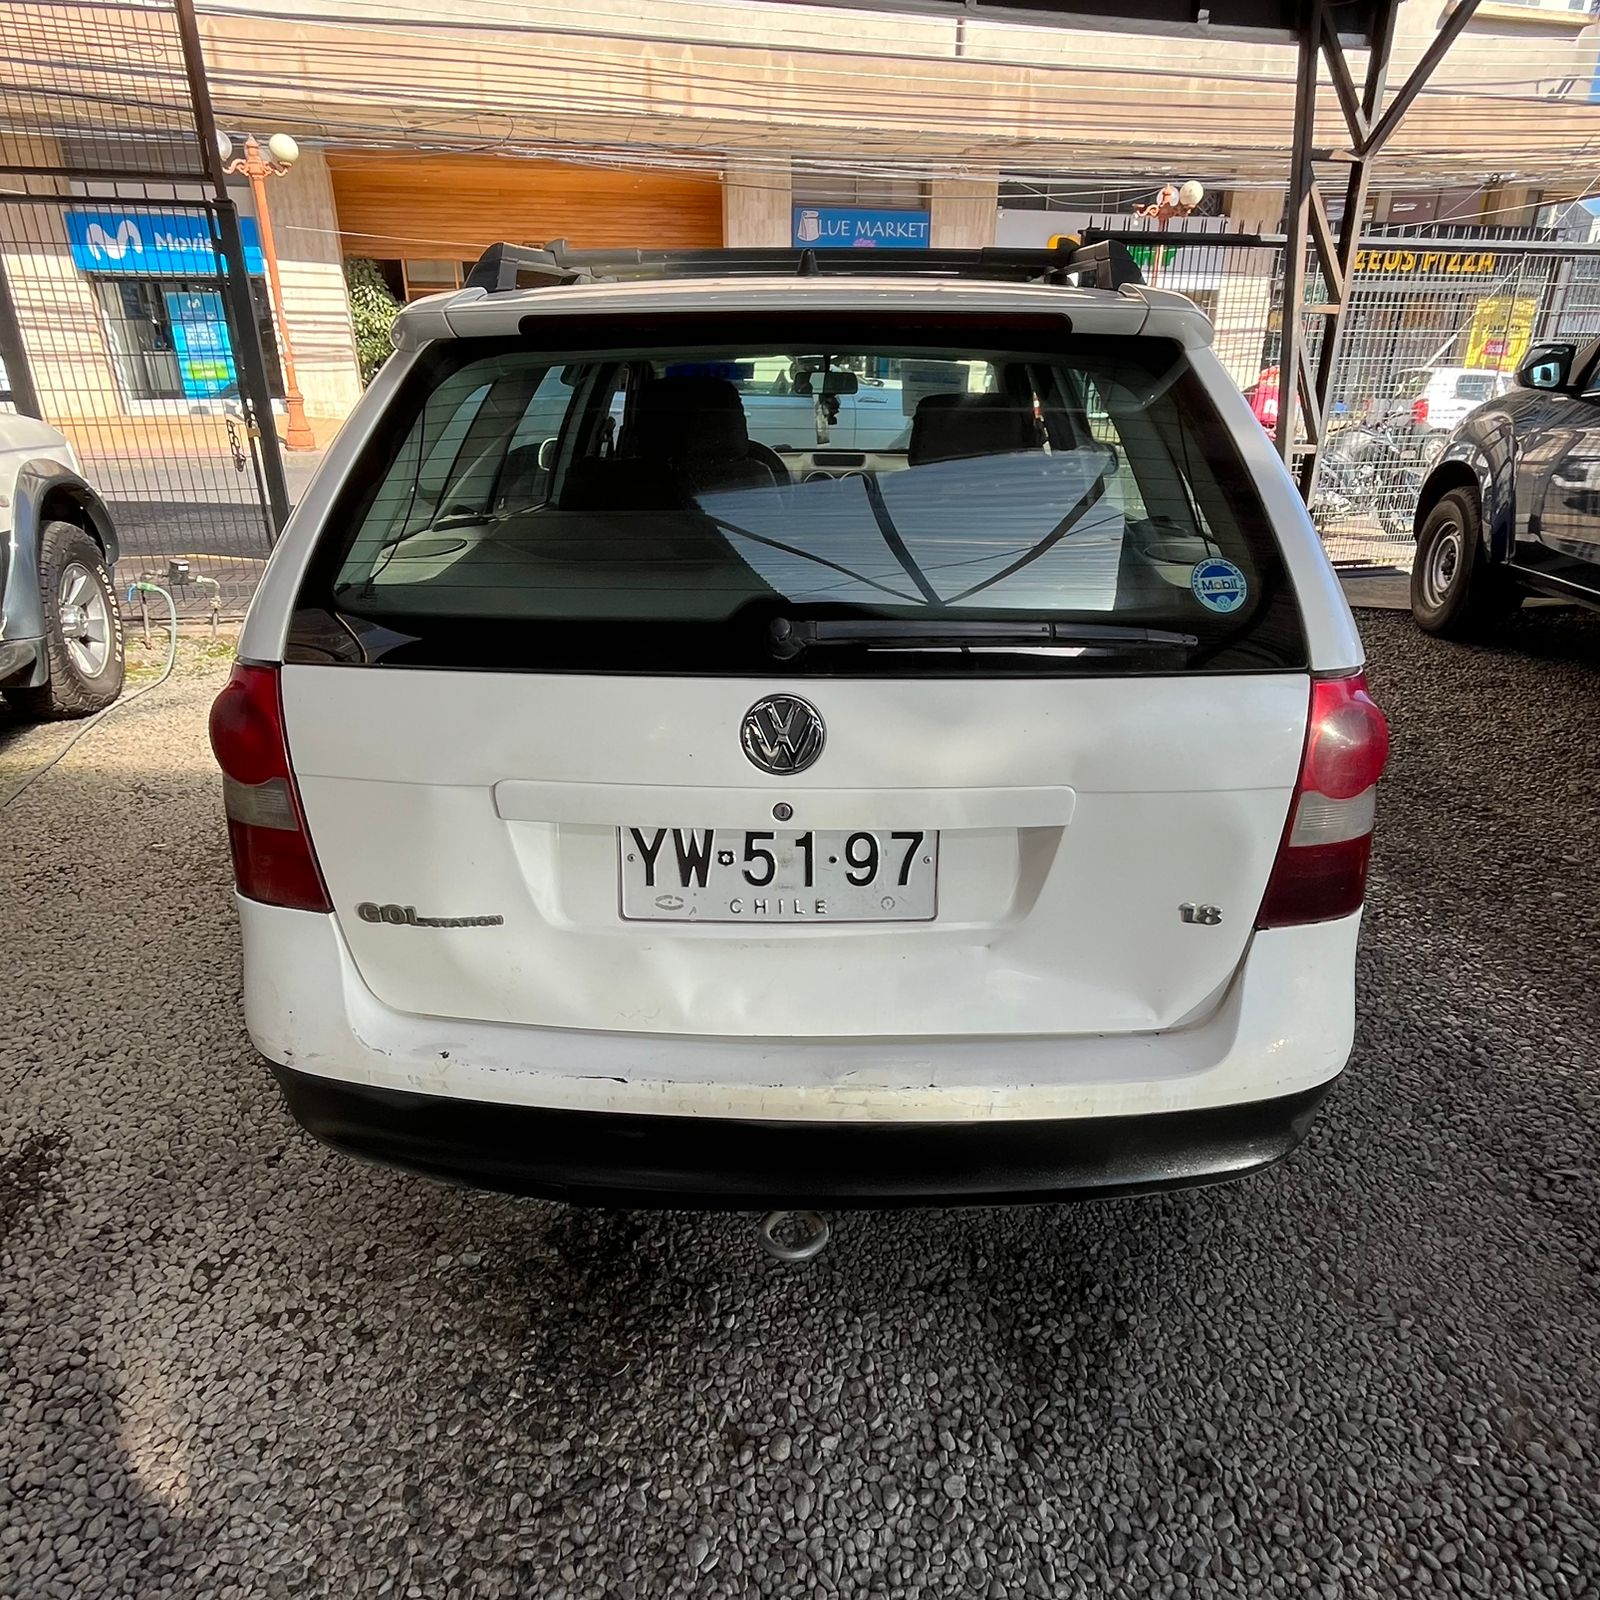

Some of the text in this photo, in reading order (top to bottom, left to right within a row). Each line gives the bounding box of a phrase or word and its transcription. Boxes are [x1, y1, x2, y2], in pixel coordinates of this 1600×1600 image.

[855, 221, 928, 238] MARKET
[154, 232, 214, 253] Movis
[1353, 250, 1495, 272] ZEUS PIZZA
[1201, 579, 1237, 590] Mobil
[355, 902, 420, 926] GOL
[729, 899, 828, 915] CHILE
